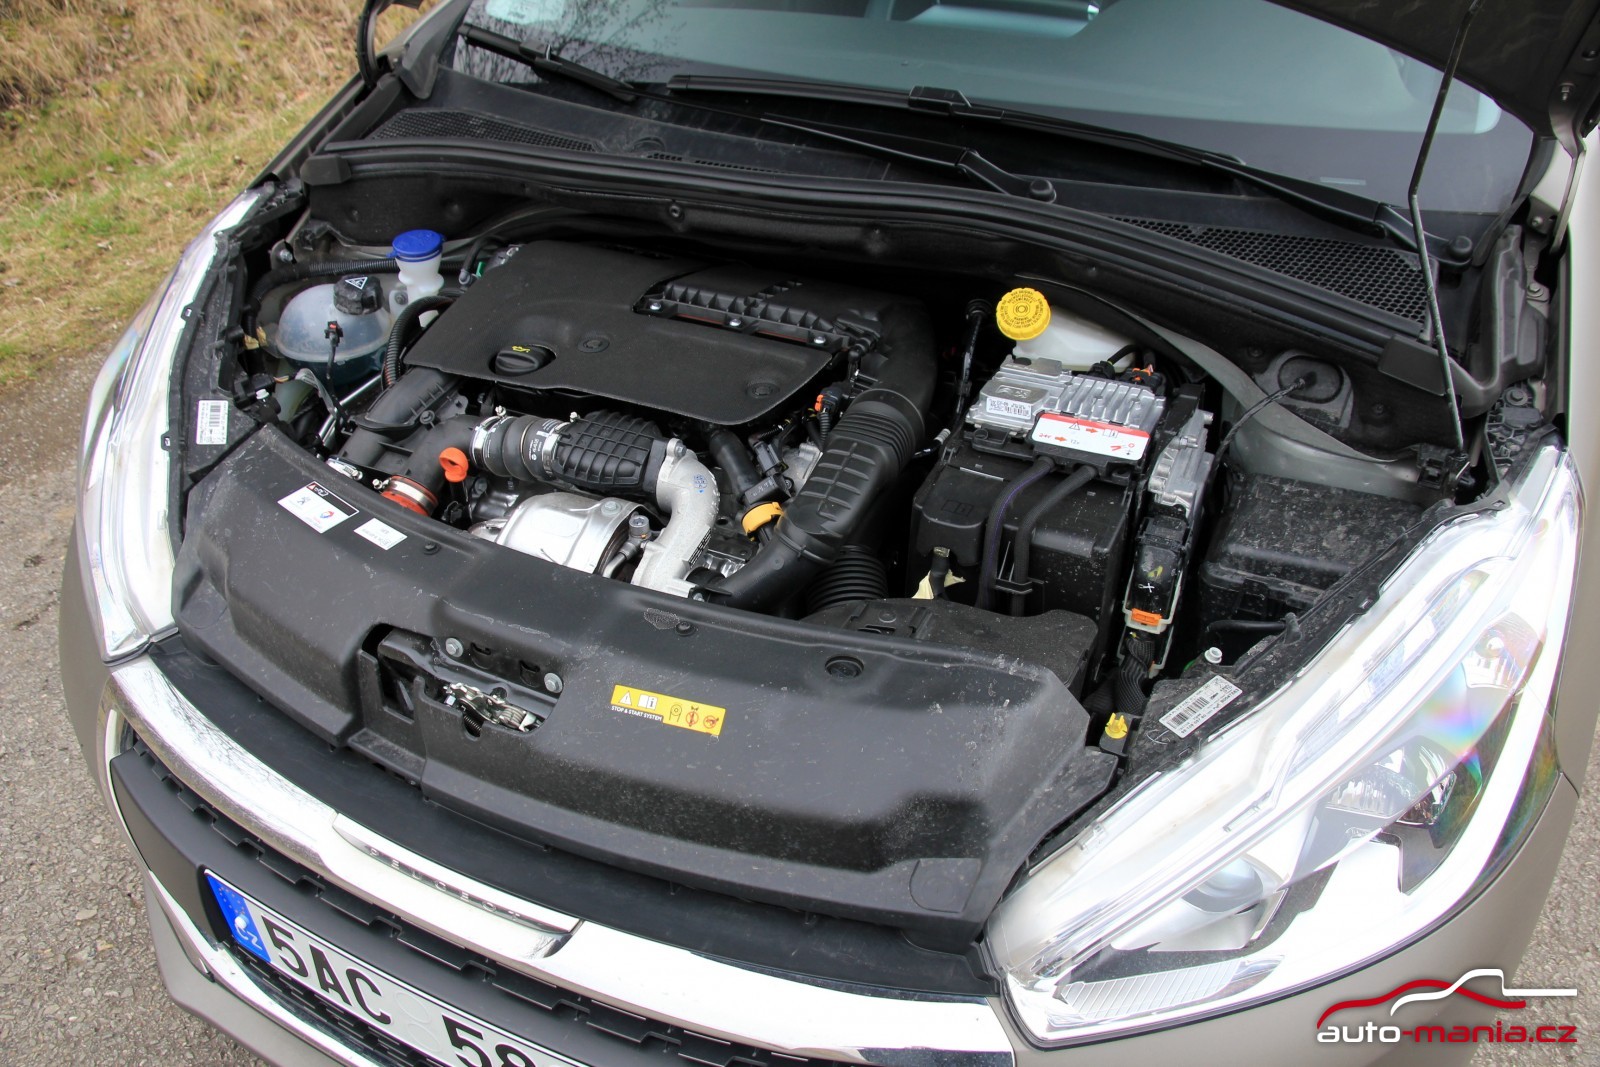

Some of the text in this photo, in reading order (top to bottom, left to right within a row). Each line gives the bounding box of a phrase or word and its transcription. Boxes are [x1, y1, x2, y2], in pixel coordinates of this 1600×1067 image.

[611, 705, 624, 713] STOP
[644, 713, 662, 721] SYSTEM
[235, 924, 263, 951] CZ
[261, 915, 392, 1025] 5AC
